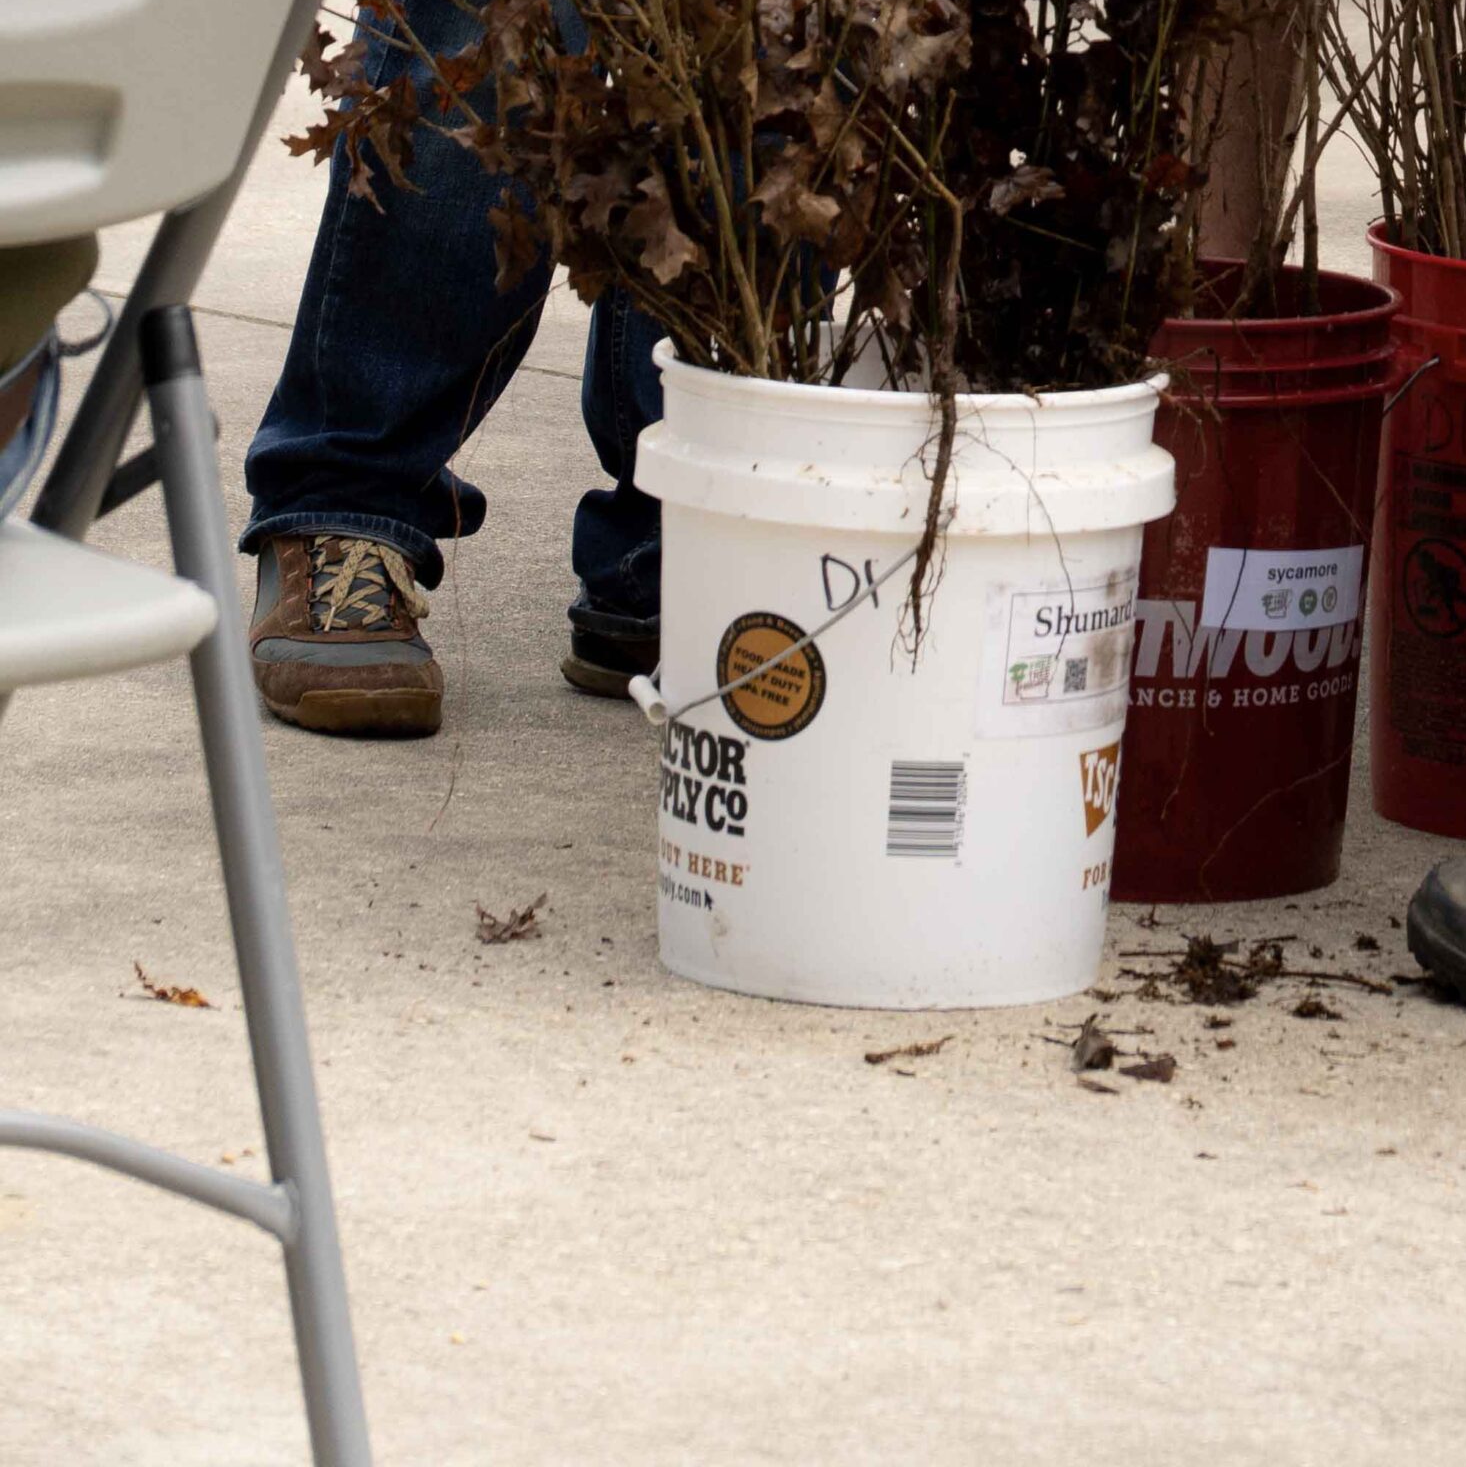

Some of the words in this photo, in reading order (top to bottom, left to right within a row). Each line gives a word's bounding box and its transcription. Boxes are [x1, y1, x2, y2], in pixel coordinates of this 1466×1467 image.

[1267, 562, 1338, 585] sycamore
[1034, 590, 1133, 638] Shumard
[1207, 689, 1223, 708] &
[1232, 685, 1300, 708] HOME
[687, 851, 743, 887] HERE
